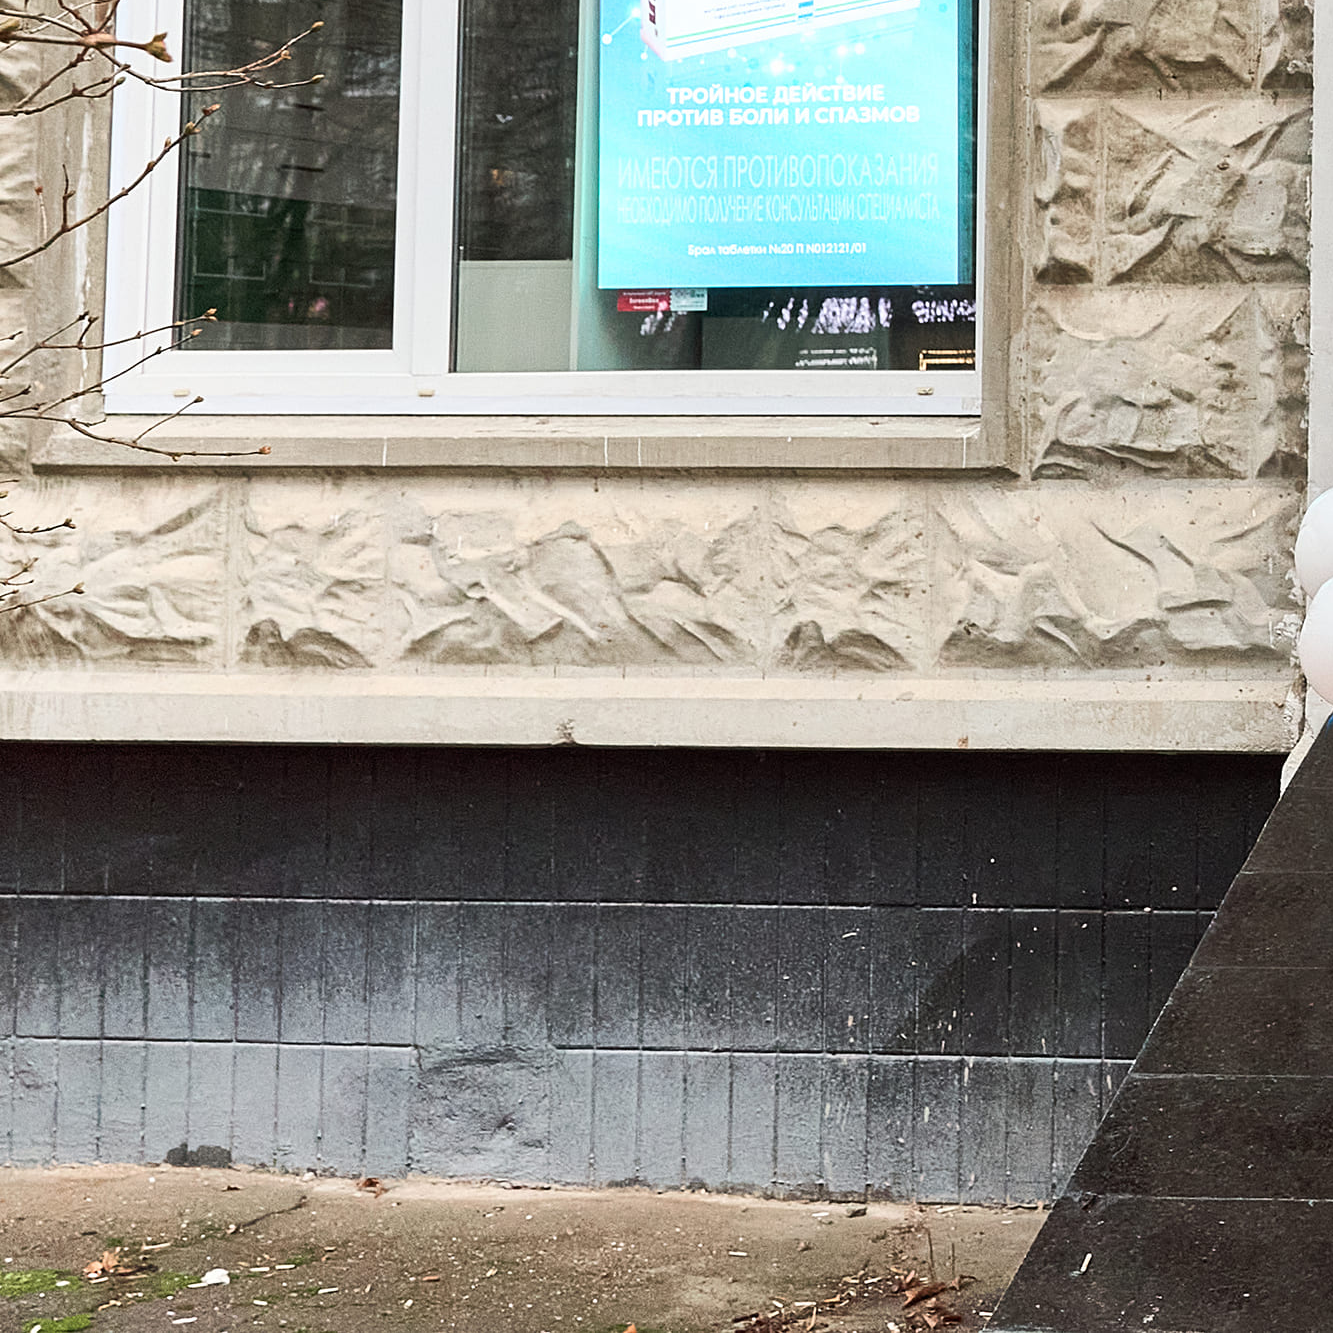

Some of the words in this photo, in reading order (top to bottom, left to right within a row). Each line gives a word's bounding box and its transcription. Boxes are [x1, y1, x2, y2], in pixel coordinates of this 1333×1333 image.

[666, 83, 769, 105] ТРОЙНОЕ
[773, 82, 885, 105] ДЕЙСТВИЕ
[637, 109, 724, 127] ПРОТИВ
[729, 108, 789, 126] БОЛИ
[794, 107, 810, 125] И
[814, 106, 920, 124] СПАЗМОВ
[618, 155, 718, 190] ИМЕЮТСЯ
[723, 153, 939, 188] ПРОТИВОПОКАЗАНИЯ
[617, 195, 697, 226] НЕОБХОДИМО
[698, 194, 764, 224] ПОЛУЧЕНИЕ
[766, 193, 855, 224] КОНСУЛЬТАЦИИ
[856, 192, 940, 224] СПЕЦИАЛИСТА
[688, 244, 715, 257] Брал
[717, 244, 767, 254] таблетки
